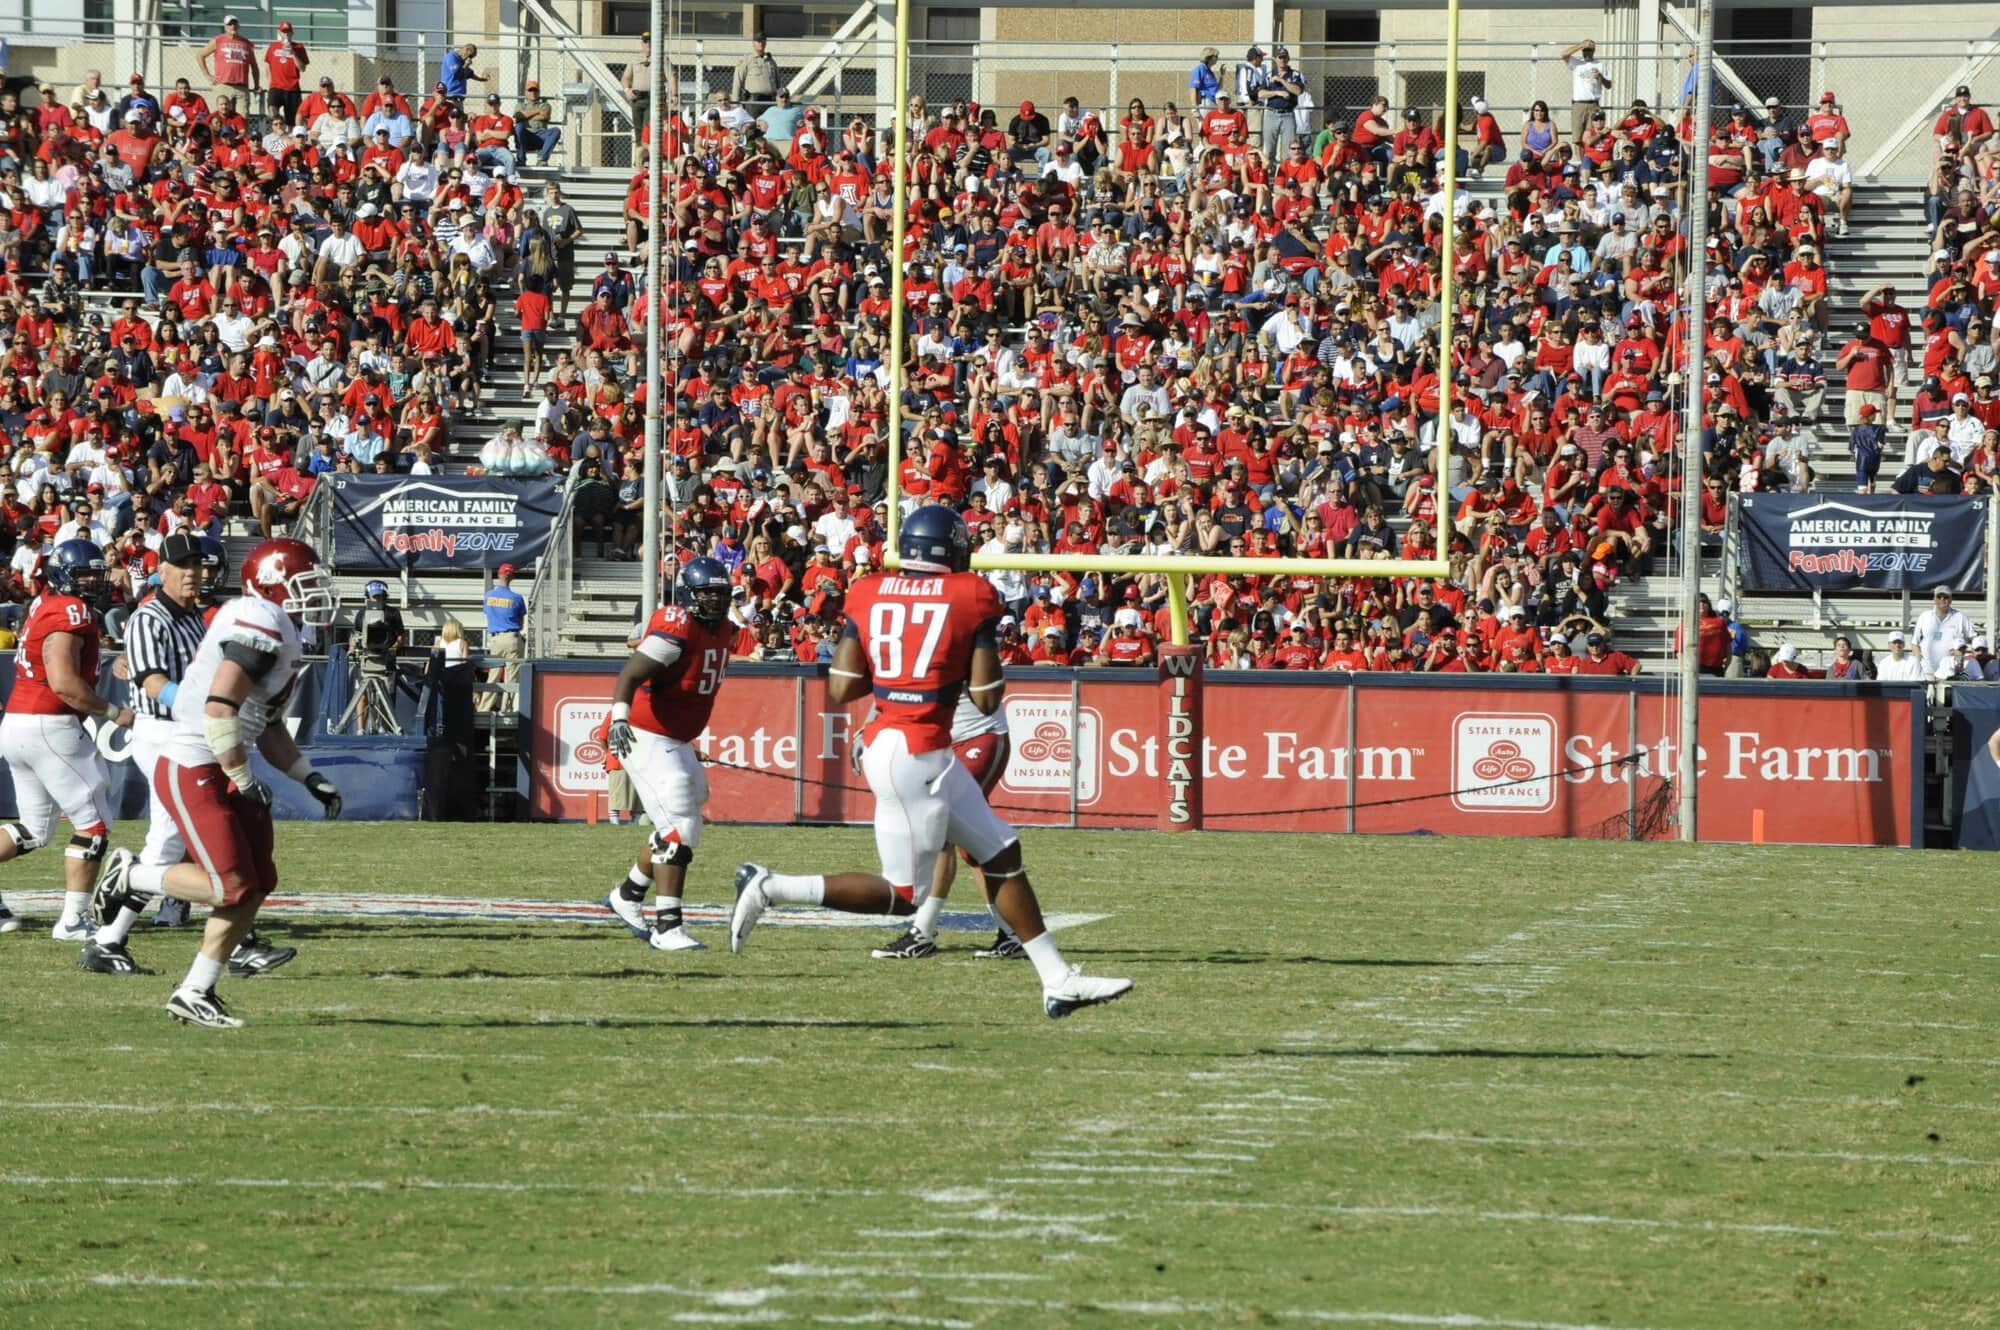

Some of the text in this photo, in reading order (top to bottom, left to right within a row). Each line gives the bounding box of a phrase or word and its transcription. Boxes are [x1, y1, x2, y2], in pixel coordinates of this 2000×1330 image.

[383, 500, 516, 513] AMERICAN FAMILY
[393, 515, 505, 524] INSURANCE
[1790, 520, 1932, 532] AMERICAN FAMILY
[1801, 535, 1919, 544] INSURANCE
[878, 577, 944, 596] MILLER
[65, 603, 91, 625] 64
[664, 607, 688, 624] 54
[870, 602, 950, 679] 87
[1016, 709, 1048, 717] STATE
[1164, 655, 1197, 823] WILDCATS
[1468, 727, 1502, 735] STATE
[696, 726, 797, 768] tate
[1108, 729, 1247, 778] Stte
[1263, 732, 1415, 780] Farm
[1724, 732, 1882, 782] Farm
[569, 771, 606, 779] INSUR
